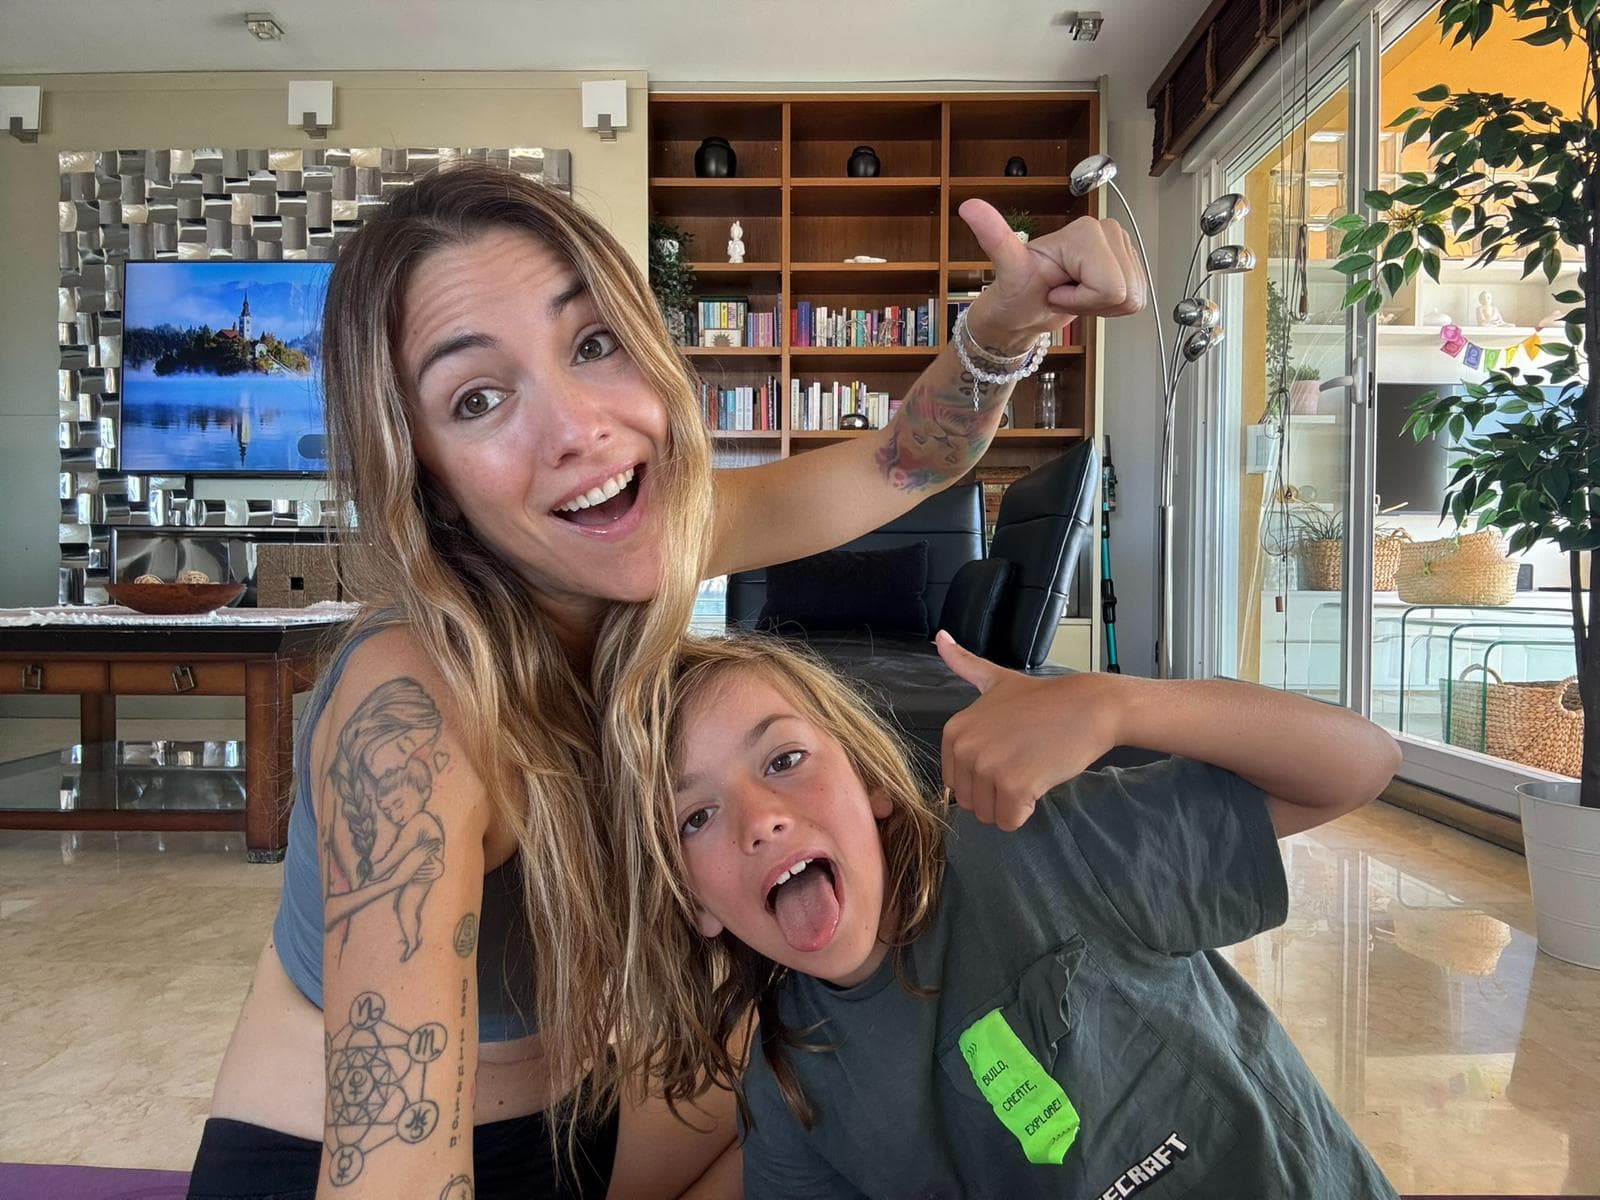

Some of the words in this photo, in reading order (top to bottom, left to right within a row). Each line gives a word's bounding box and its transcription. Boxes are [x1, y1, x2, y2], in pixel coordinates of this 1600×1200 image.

[981, 1059, 1009, 1087] BUILD,
[1002, 1079, 1037, 1112] CREATE,
[1024, 1098, 1061, 1137] EXPLORE!
[1097, 1132, 1188, 1200] ECRAFT
